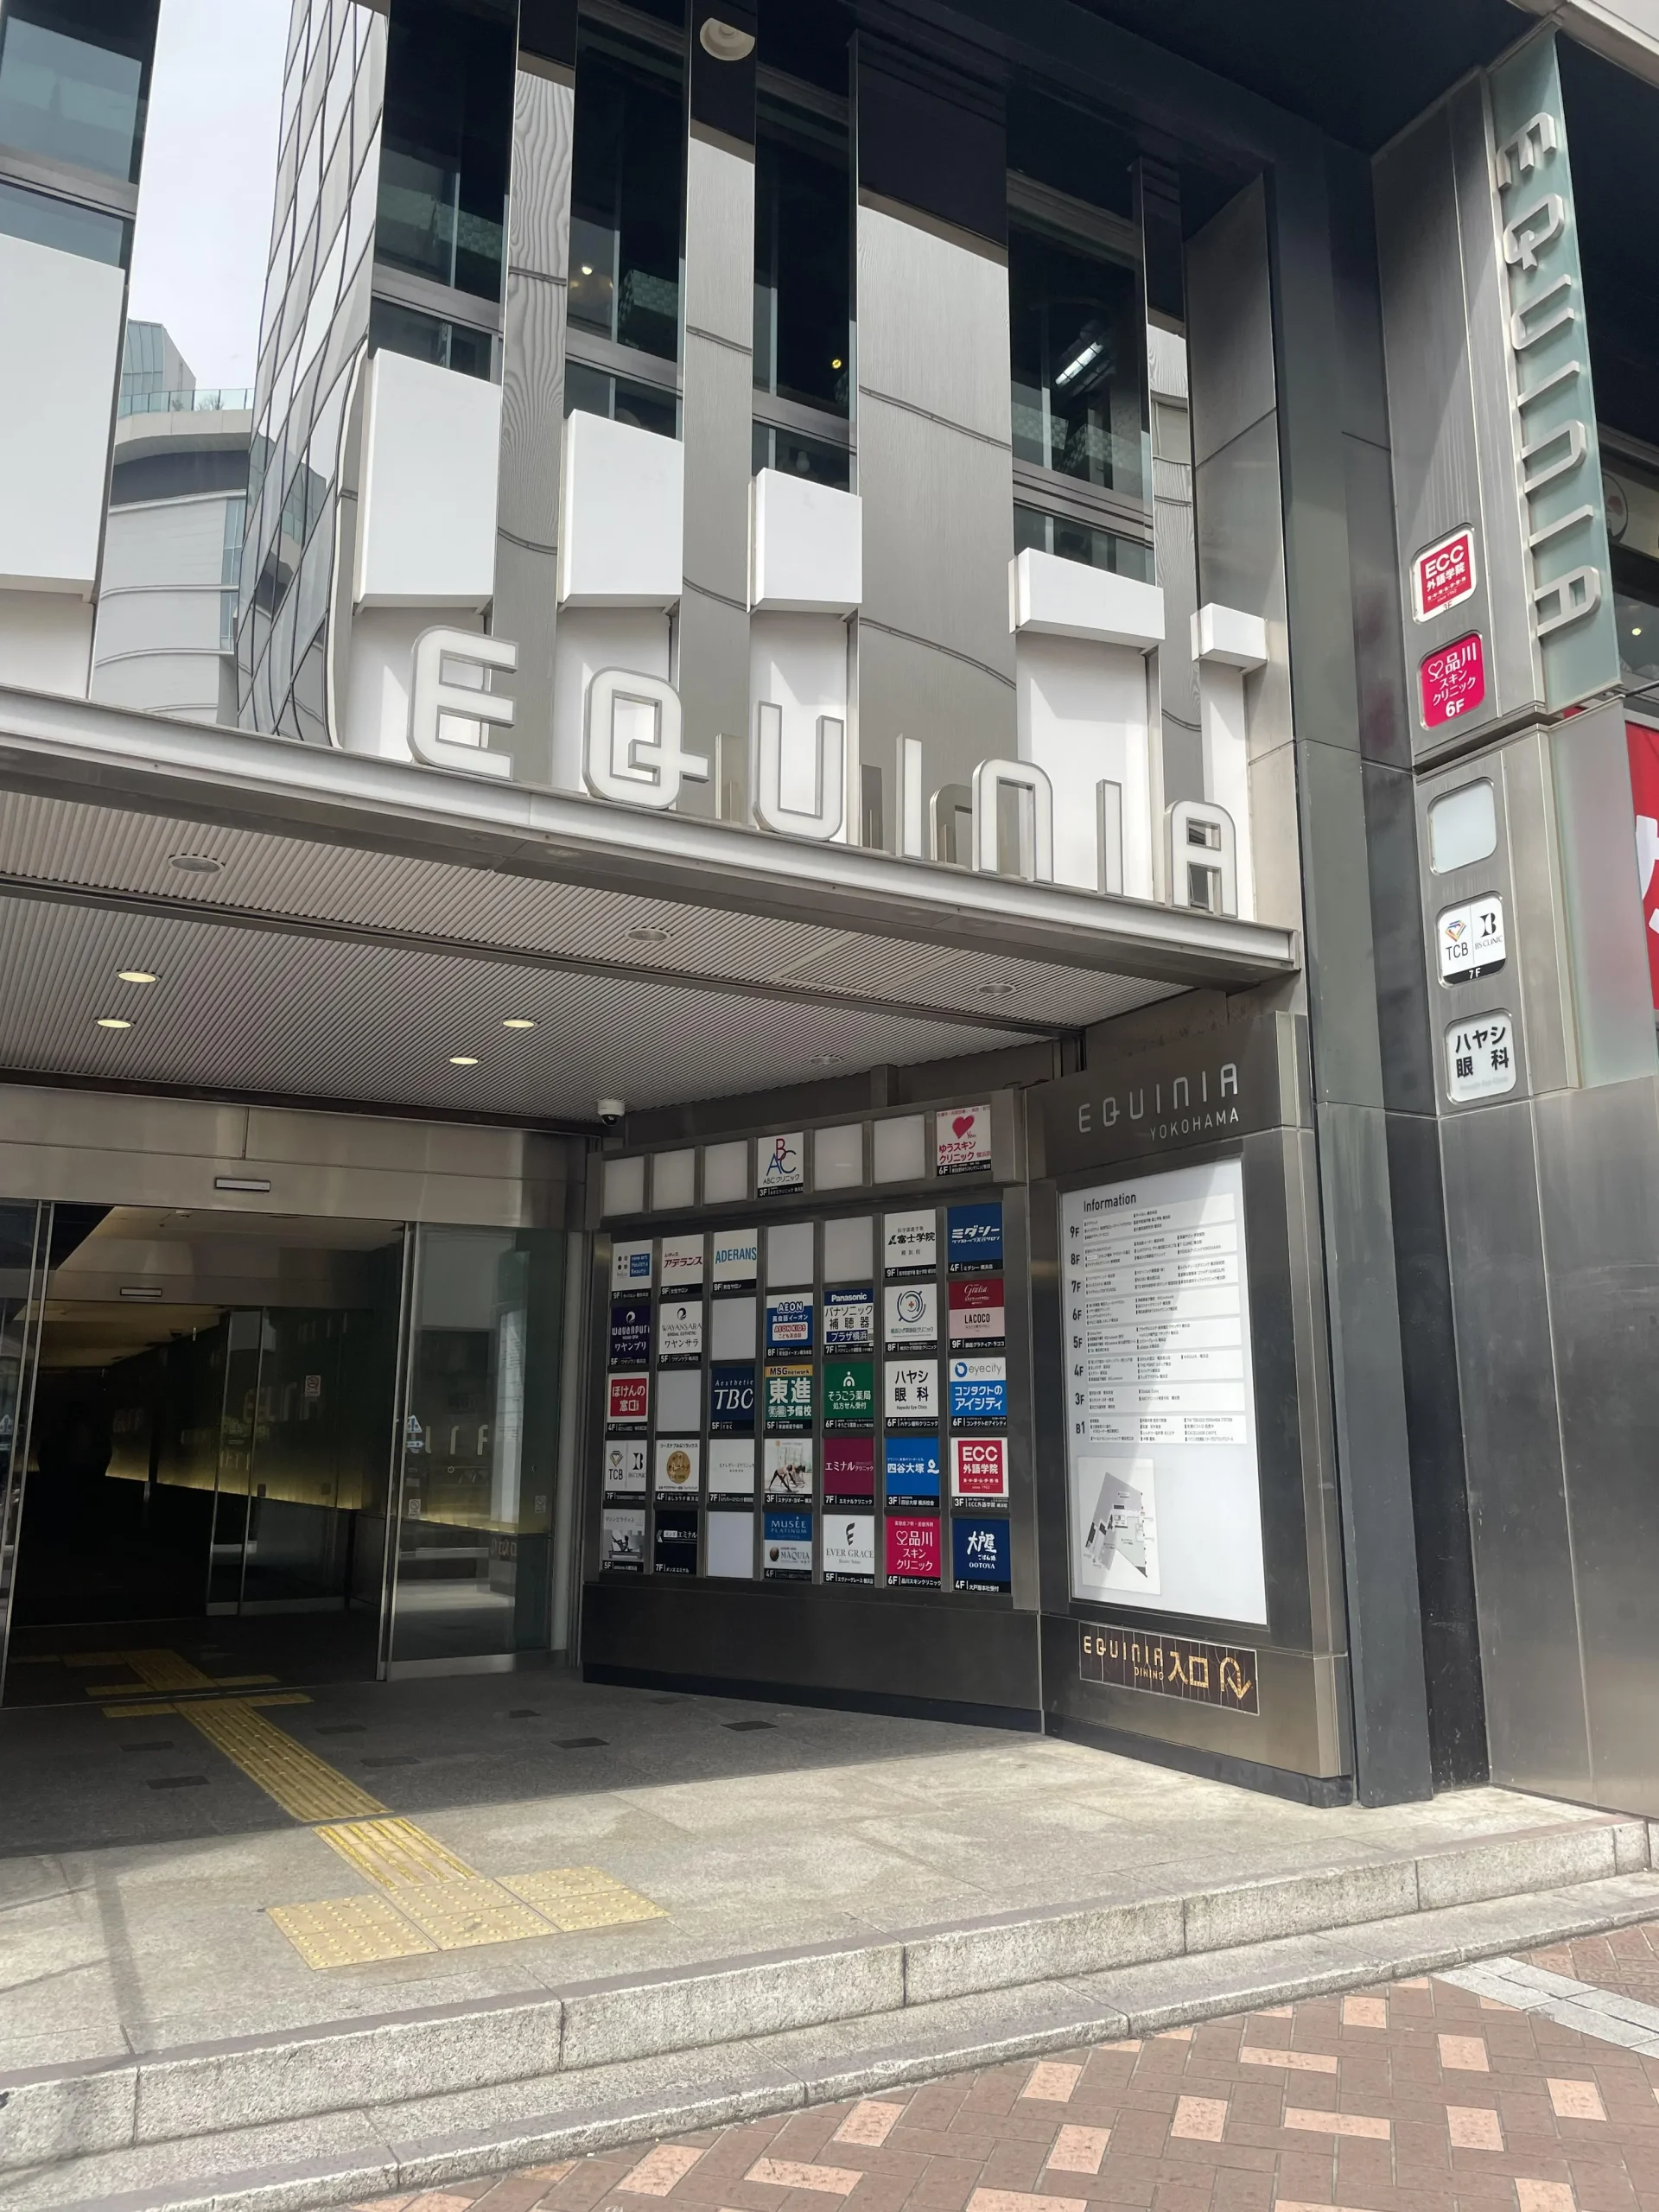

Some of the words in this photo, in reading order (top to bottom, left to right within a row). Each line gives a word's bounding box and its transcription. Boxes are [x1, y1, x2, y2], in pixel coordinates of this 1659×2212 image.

[1497, 111, 1602, 638] EQUINIA
[1425, 545, 1464, 579] ECC
[1427, 562, 1465, 592] 外語学院
[1446, 642, 1477, 674] 品川
[1440, 669, 1468, 690] スキン
[1432, 677, 1477, 706] クリニック
[1445, 698, 1465, 718] 6F
[410, 625, 1236, 918] EQUINIA
[1446, 942, 1468, 960] TCB
[1469, 967, 1481, 980] 7F
[1455, 1026, 1506, 1054] ハヤシ
[1079, 1062, 1238, 1133] EQUINIA
[1150, 1107, 1239, 1141] YOKOHAMA
[939, 1141, 976, 1154] ゆうスキン
[940, 1151, 974, 1164] クリニック
[939, 1166, 948, 1175] 6F
[1084, 1193, 1136, 1212] Information
[897, 1232, 935, 1244] 富士学院
[952, 1225, 1000, 1239] ミダシー
[1070, 1226, 1079, 1238] 9F
[715, 1247, 757, 1264] ADERANS
[1071, 1253, 1080, 1265] 8F
[887, 1269, 896, 1277] 9F
[1071, 1280, 1081, 1293] 7F
[831, 1293, 867, 1302] Panasonic
[778, 1301, 803, 1312] AEON
[825, 1305, 873, 1317] パナソニック
[772, 1314, 808, 1322] 英会話イーオン
[965, 1314, 990, 1324] LACOCO
[1073, 1308, 1082, 1321] 6F
[662, 1323, 702, 1332] WAYANSARA
[831, 1331, 867, 1342] プラザ横浜
[1073, 1336, 1082, 1349] 5F
[615, 1341, 646, 1352] ワヤンプリ
[665, 1339, 699, 1348] ワヤンサラ
[887, 1343, 896, 1351] 8F
[952, 1340, 961, 1348] 9F
[969, 1364, 1002, 1376] eyecity
[1074, 1364, 1084, 1377] 4F
[895, 1370, 928, 1384] ハヤシ
[612, 1385, 645, 1397] ほけんの
[769, 1377, 811, 1404] 東進
[955, 1385, 1002, 1396] コンタクトの
[714, 1388, 753, 1409] TBC
[955, 1397, 1002, 1410] アイシティ
[1075, 1392, 1085, 1405] 3F
[768, 1405, 812, 1417] 衛星予備校
[953, 1418, 962, 1426] 6F
[1076, 1421, 1085, 1434] B1
[962, 1446, 998, 1462] ECC
[609, 1469, 623, 1480] TCB
[887, 1463, 924, 1474] 四谷大塚
[963, 1464, 998, 1474] 外語学院
[889, 1497, 897, 1505] 3F
[954, 1498, 964, 1507] 3F
[909, 1531, 933, 1546] 品川
[781, 1551, 810, 1560] MAQUIA
[826, 1548, 846, 1557] EVER
[848, 1550, 874, 1558] GRACE
[903, 1549, 926, 1559] スキン
[897, 1559, 933, 1571] クリニック
[888, 1576, 897, 1584] 6F
[955, 1581, 965, 1589] 4F
[1084, 1636, 1163, 1667] EQUINIA
[1168, 1651, 1209, 1689] 入口
[1134, 1666, 1164, 1681] DINING
